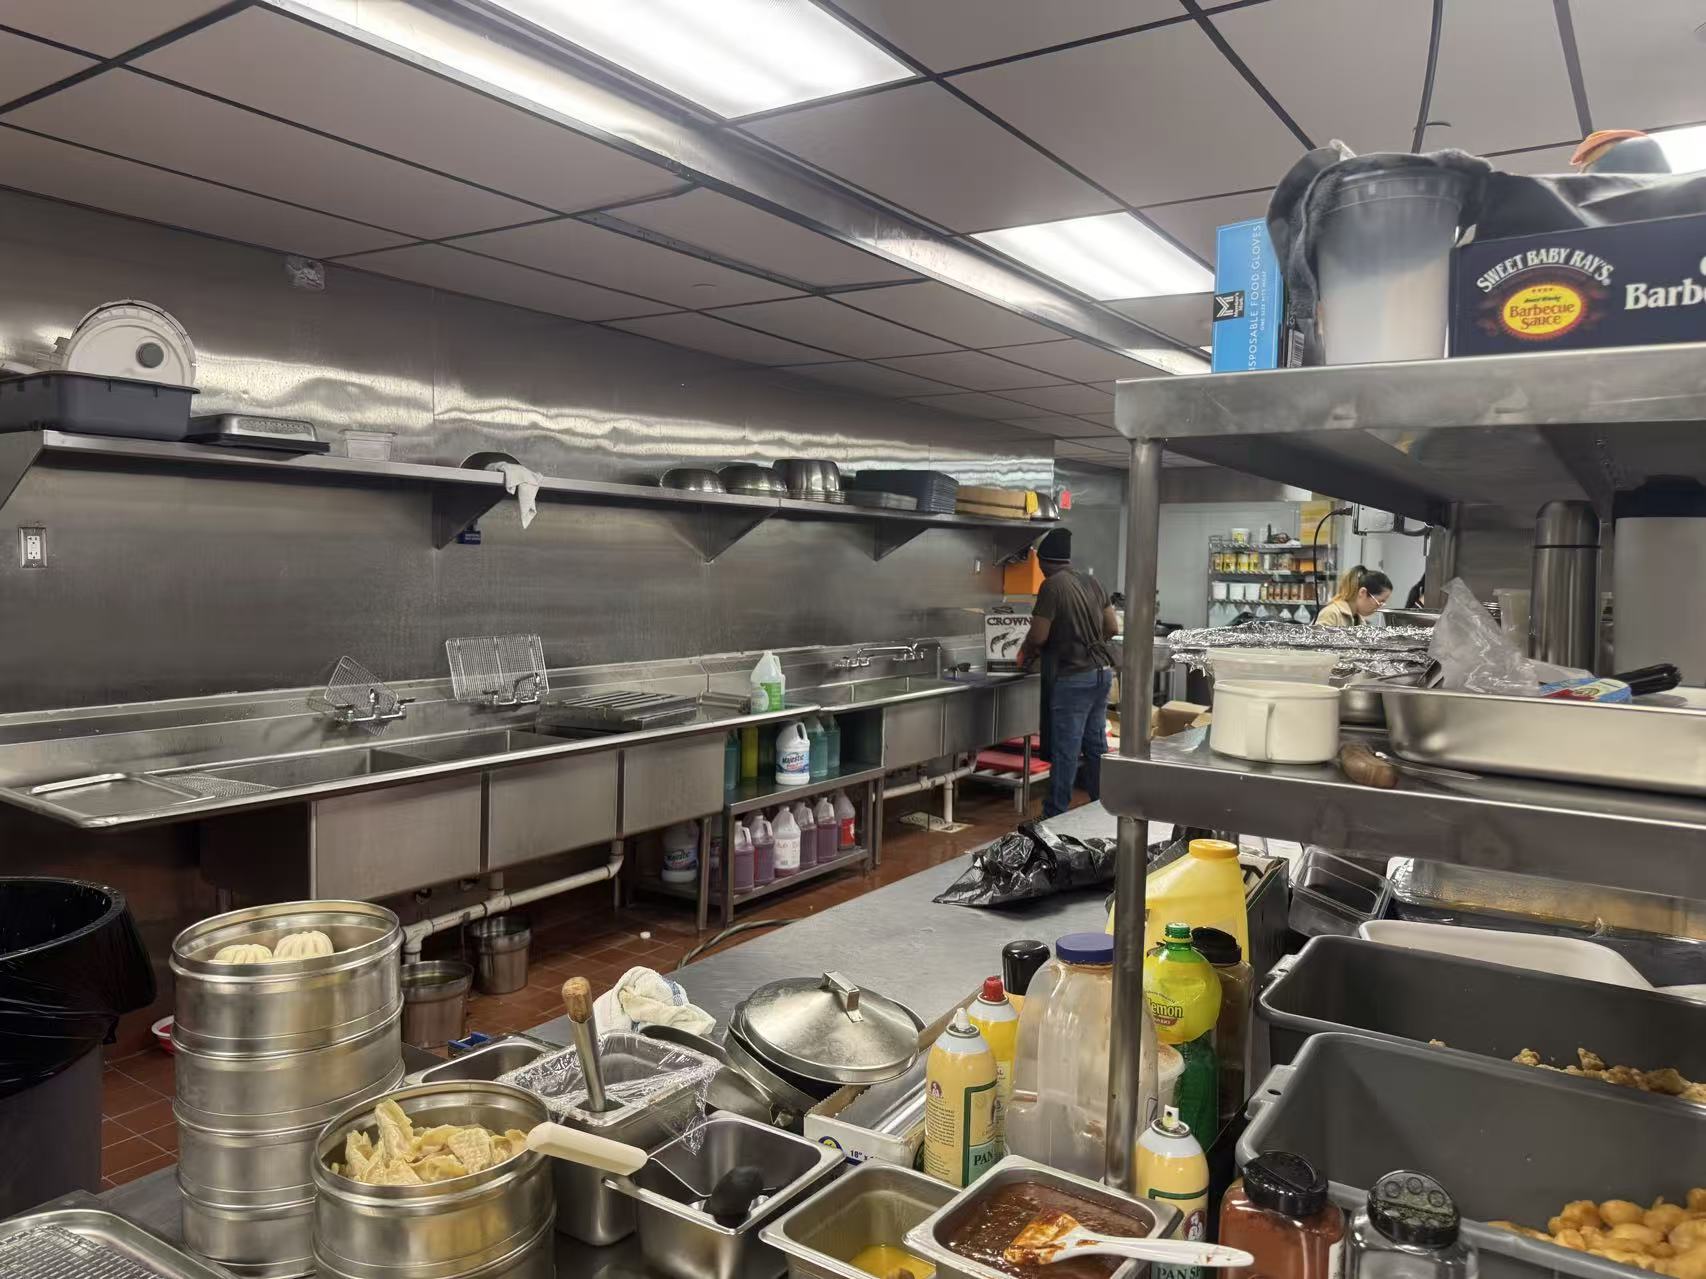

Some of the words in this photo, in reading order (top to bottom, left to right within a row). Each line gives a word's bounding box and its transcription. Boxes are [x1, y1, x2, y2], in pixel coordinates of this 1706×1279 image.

[1251, 225, 1261, 270] GLOVES
[1476, 254, 1525, 293] SWEET
[1526, 248, 1571, 266] BABY
[1569, 250, 1614, 281] RAY'S
[1250, 273, 1260, 306] FOOD
[1624, 278, 1706, 310] Barb
[1510, 304, 1575, 317] Barbecue
[1521, 315, 1561, 330] Sauce
[1248, 310, 1259, 370] ISPOSABLE
[986, 616, 1032, 626] CROWN
[1157, 1267, 1188, 1279] PAN
